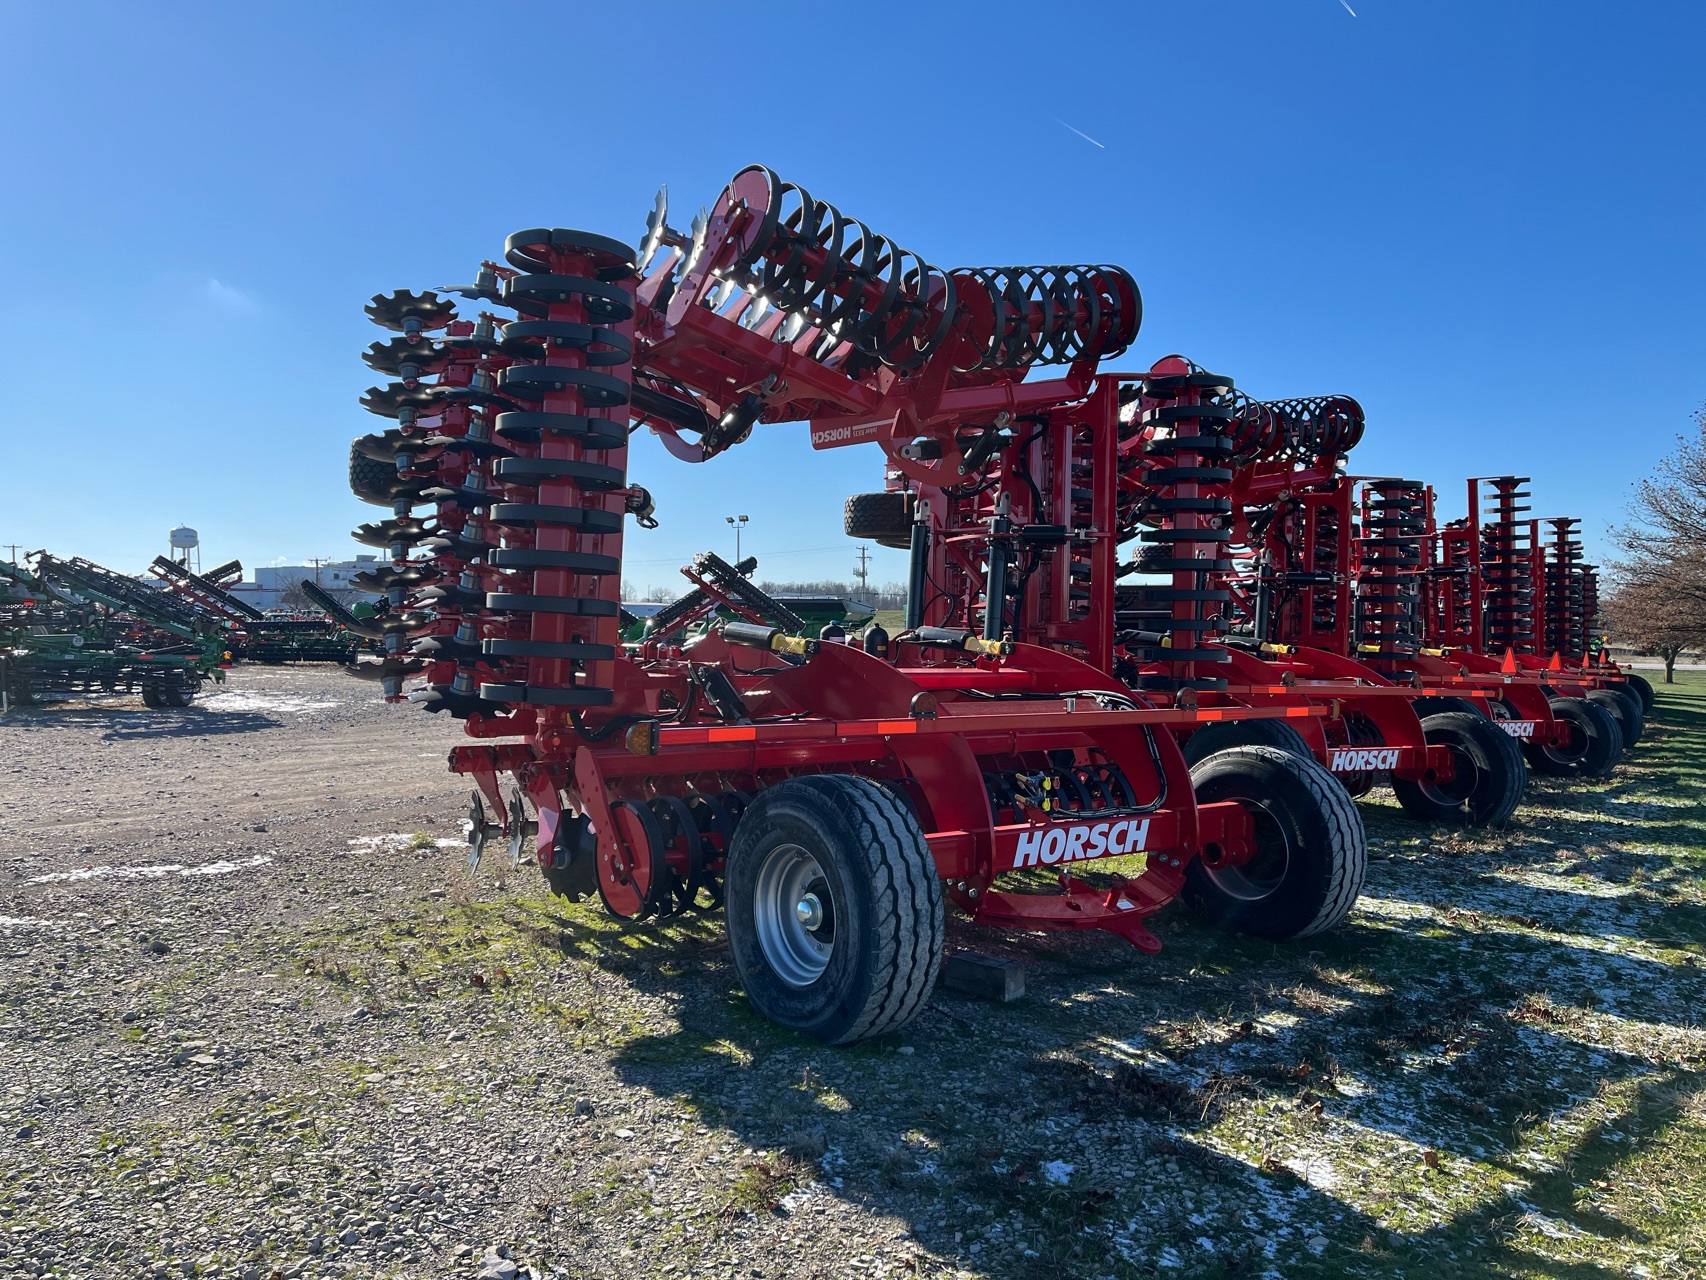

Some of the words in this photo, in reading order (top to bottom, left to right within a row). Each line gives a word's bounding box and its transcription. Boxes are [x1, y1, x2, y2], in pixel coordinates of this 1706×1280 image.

[812, 426, 851, 444] HORSCH
[1331, 749, 1400, 772] HORSCH
[1013, 818, 1150, 868] HORSCH
